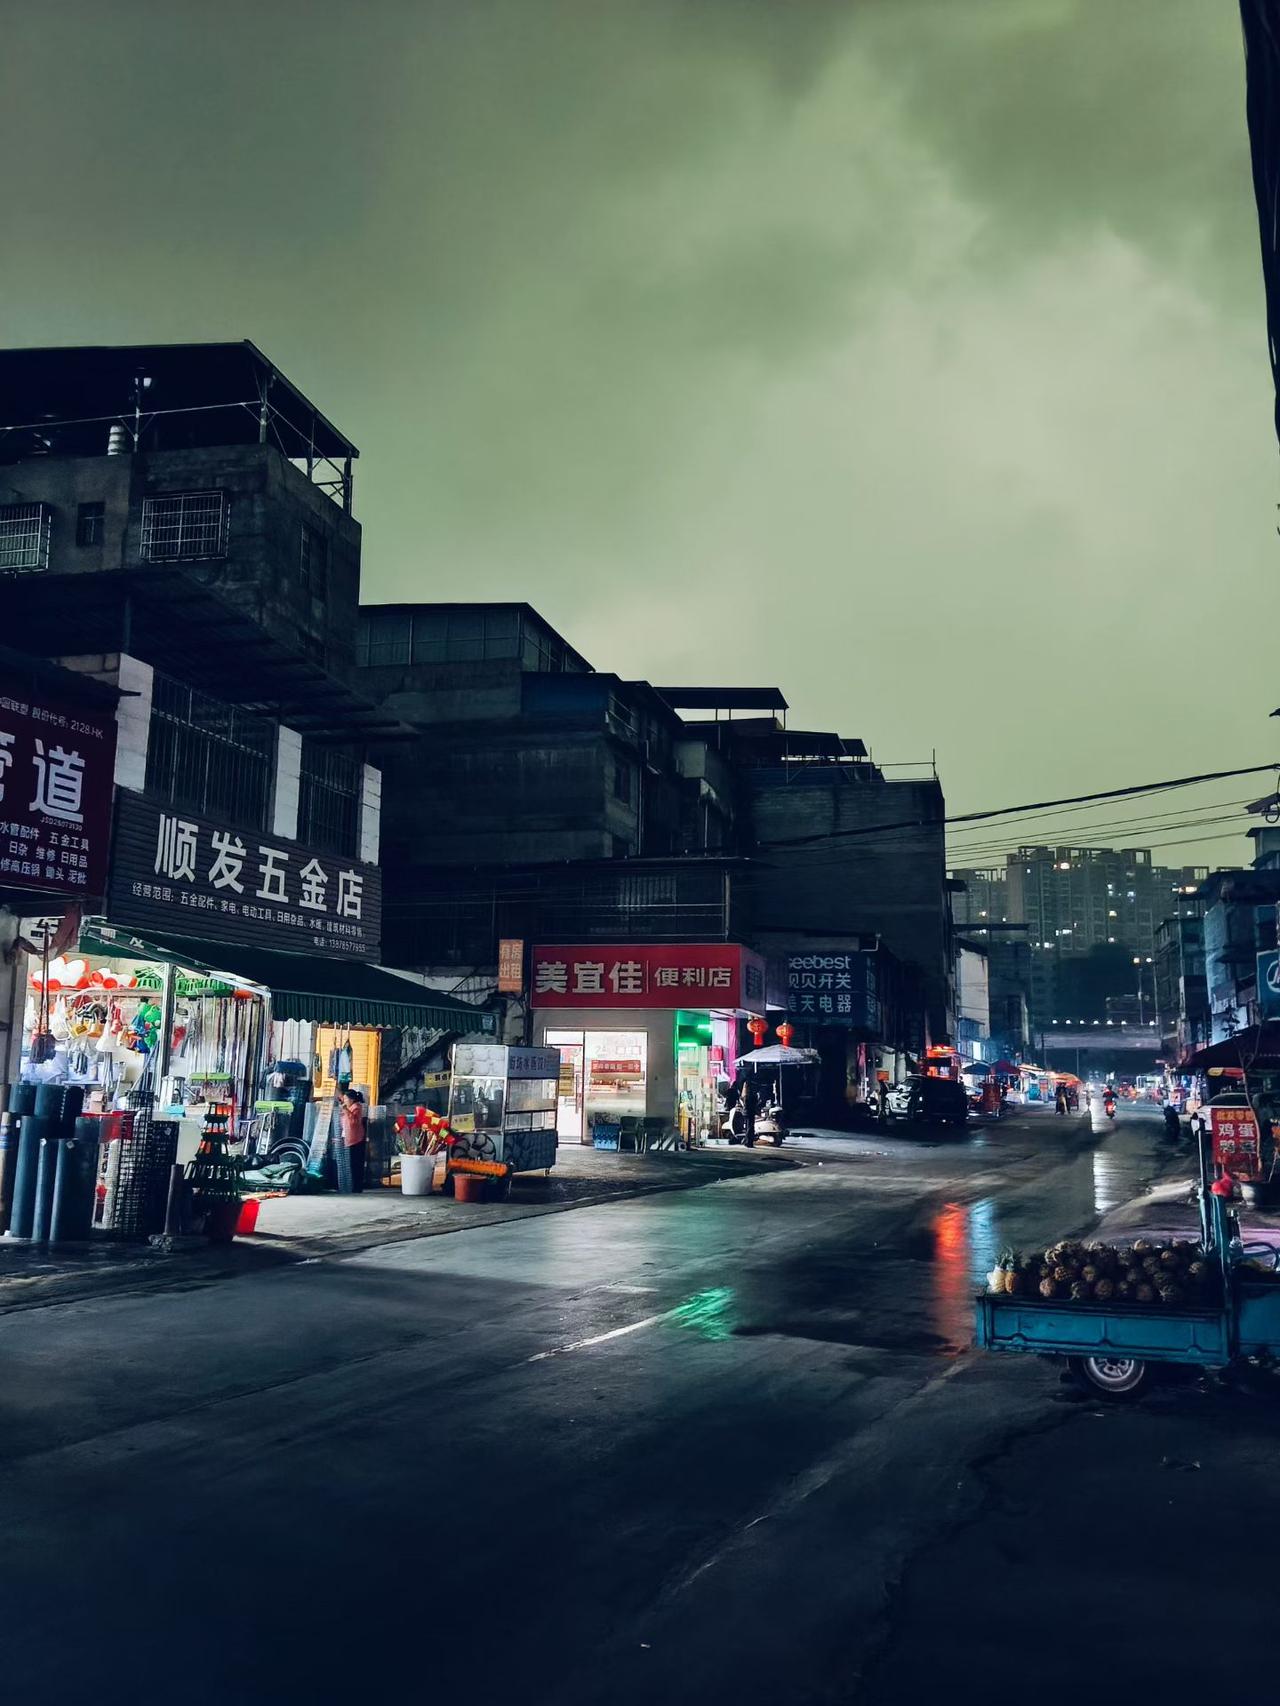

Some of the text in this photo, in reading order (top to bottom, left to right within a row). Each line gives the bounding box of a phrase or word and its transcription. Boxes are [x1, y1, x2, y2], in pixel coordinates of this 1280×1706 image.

[0, 730, 84, 824] 道
[9, 840, 88, 868] 日杂 维修 日用品
[49, 831, 89, 852] 五金工具
[154, 813, 364, 920] 顺发五金店
[500, 961, 522, 979] 出租
[535, 960, 643, 994] 美宜佳
[654, 966, 732, 988] 便利店
[1218, 1123, 1255, 1137] 鸡蛋
